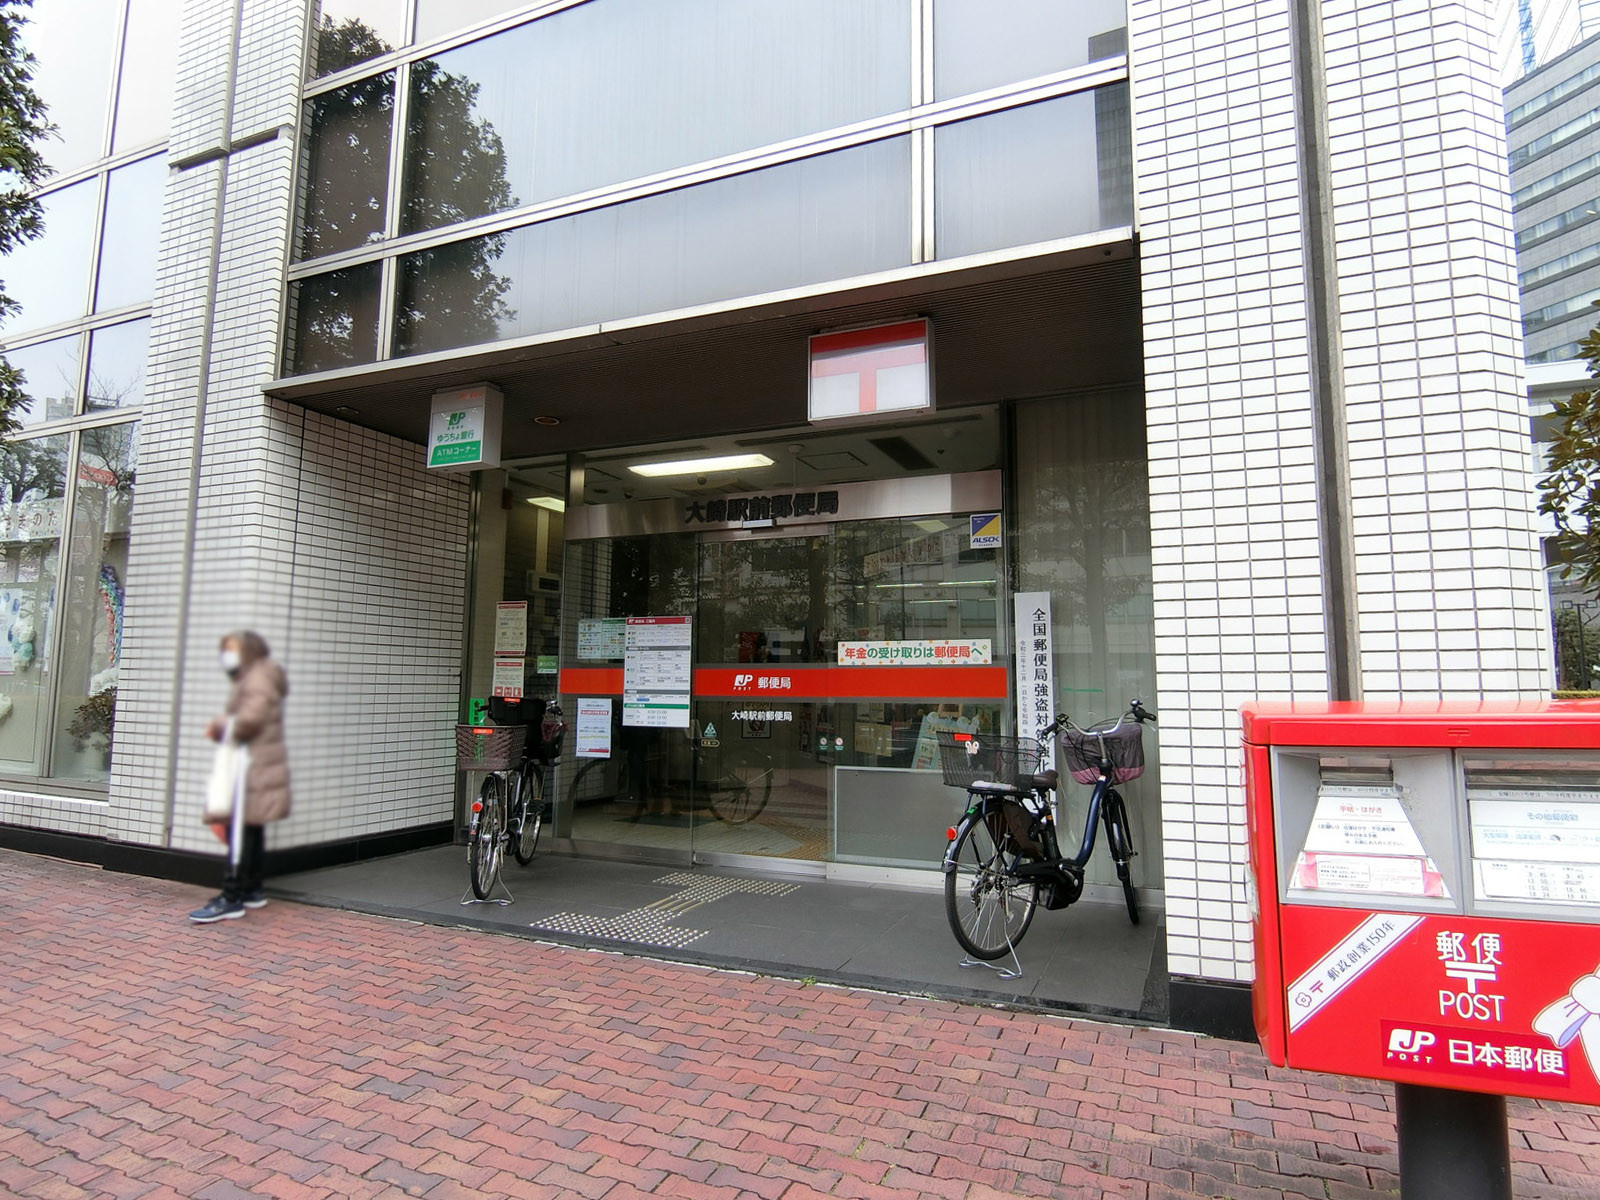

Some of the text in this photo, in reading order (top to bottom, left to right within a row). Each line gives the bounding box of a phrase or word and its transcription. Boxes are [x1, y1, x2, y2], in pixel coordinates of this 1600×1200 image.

[437, 430, 475, 442] ゆうちょ銀行
[437, 446, 477, 457] ATMコーナー
[685, 490, 839, 524] 大崎駅前郵便局
[972, 536, 1000, 544] ALSOK
[844, 645, 983, 660] 年金の受け取りは郵便局へ
[757, 677, 792, 689] 郵便局
[731, 710, 793, 722] 大崎駅前郵便局
[1326, 918, 1396, 983] 郵政創業150年
[1436, 930, 1503, 966] 郵便
[1438, 990, 1505, 1022] POST
[1387, 1052, 1434, 1064] POST
[1449, 1039, 1566, 1076] 日本郵便
